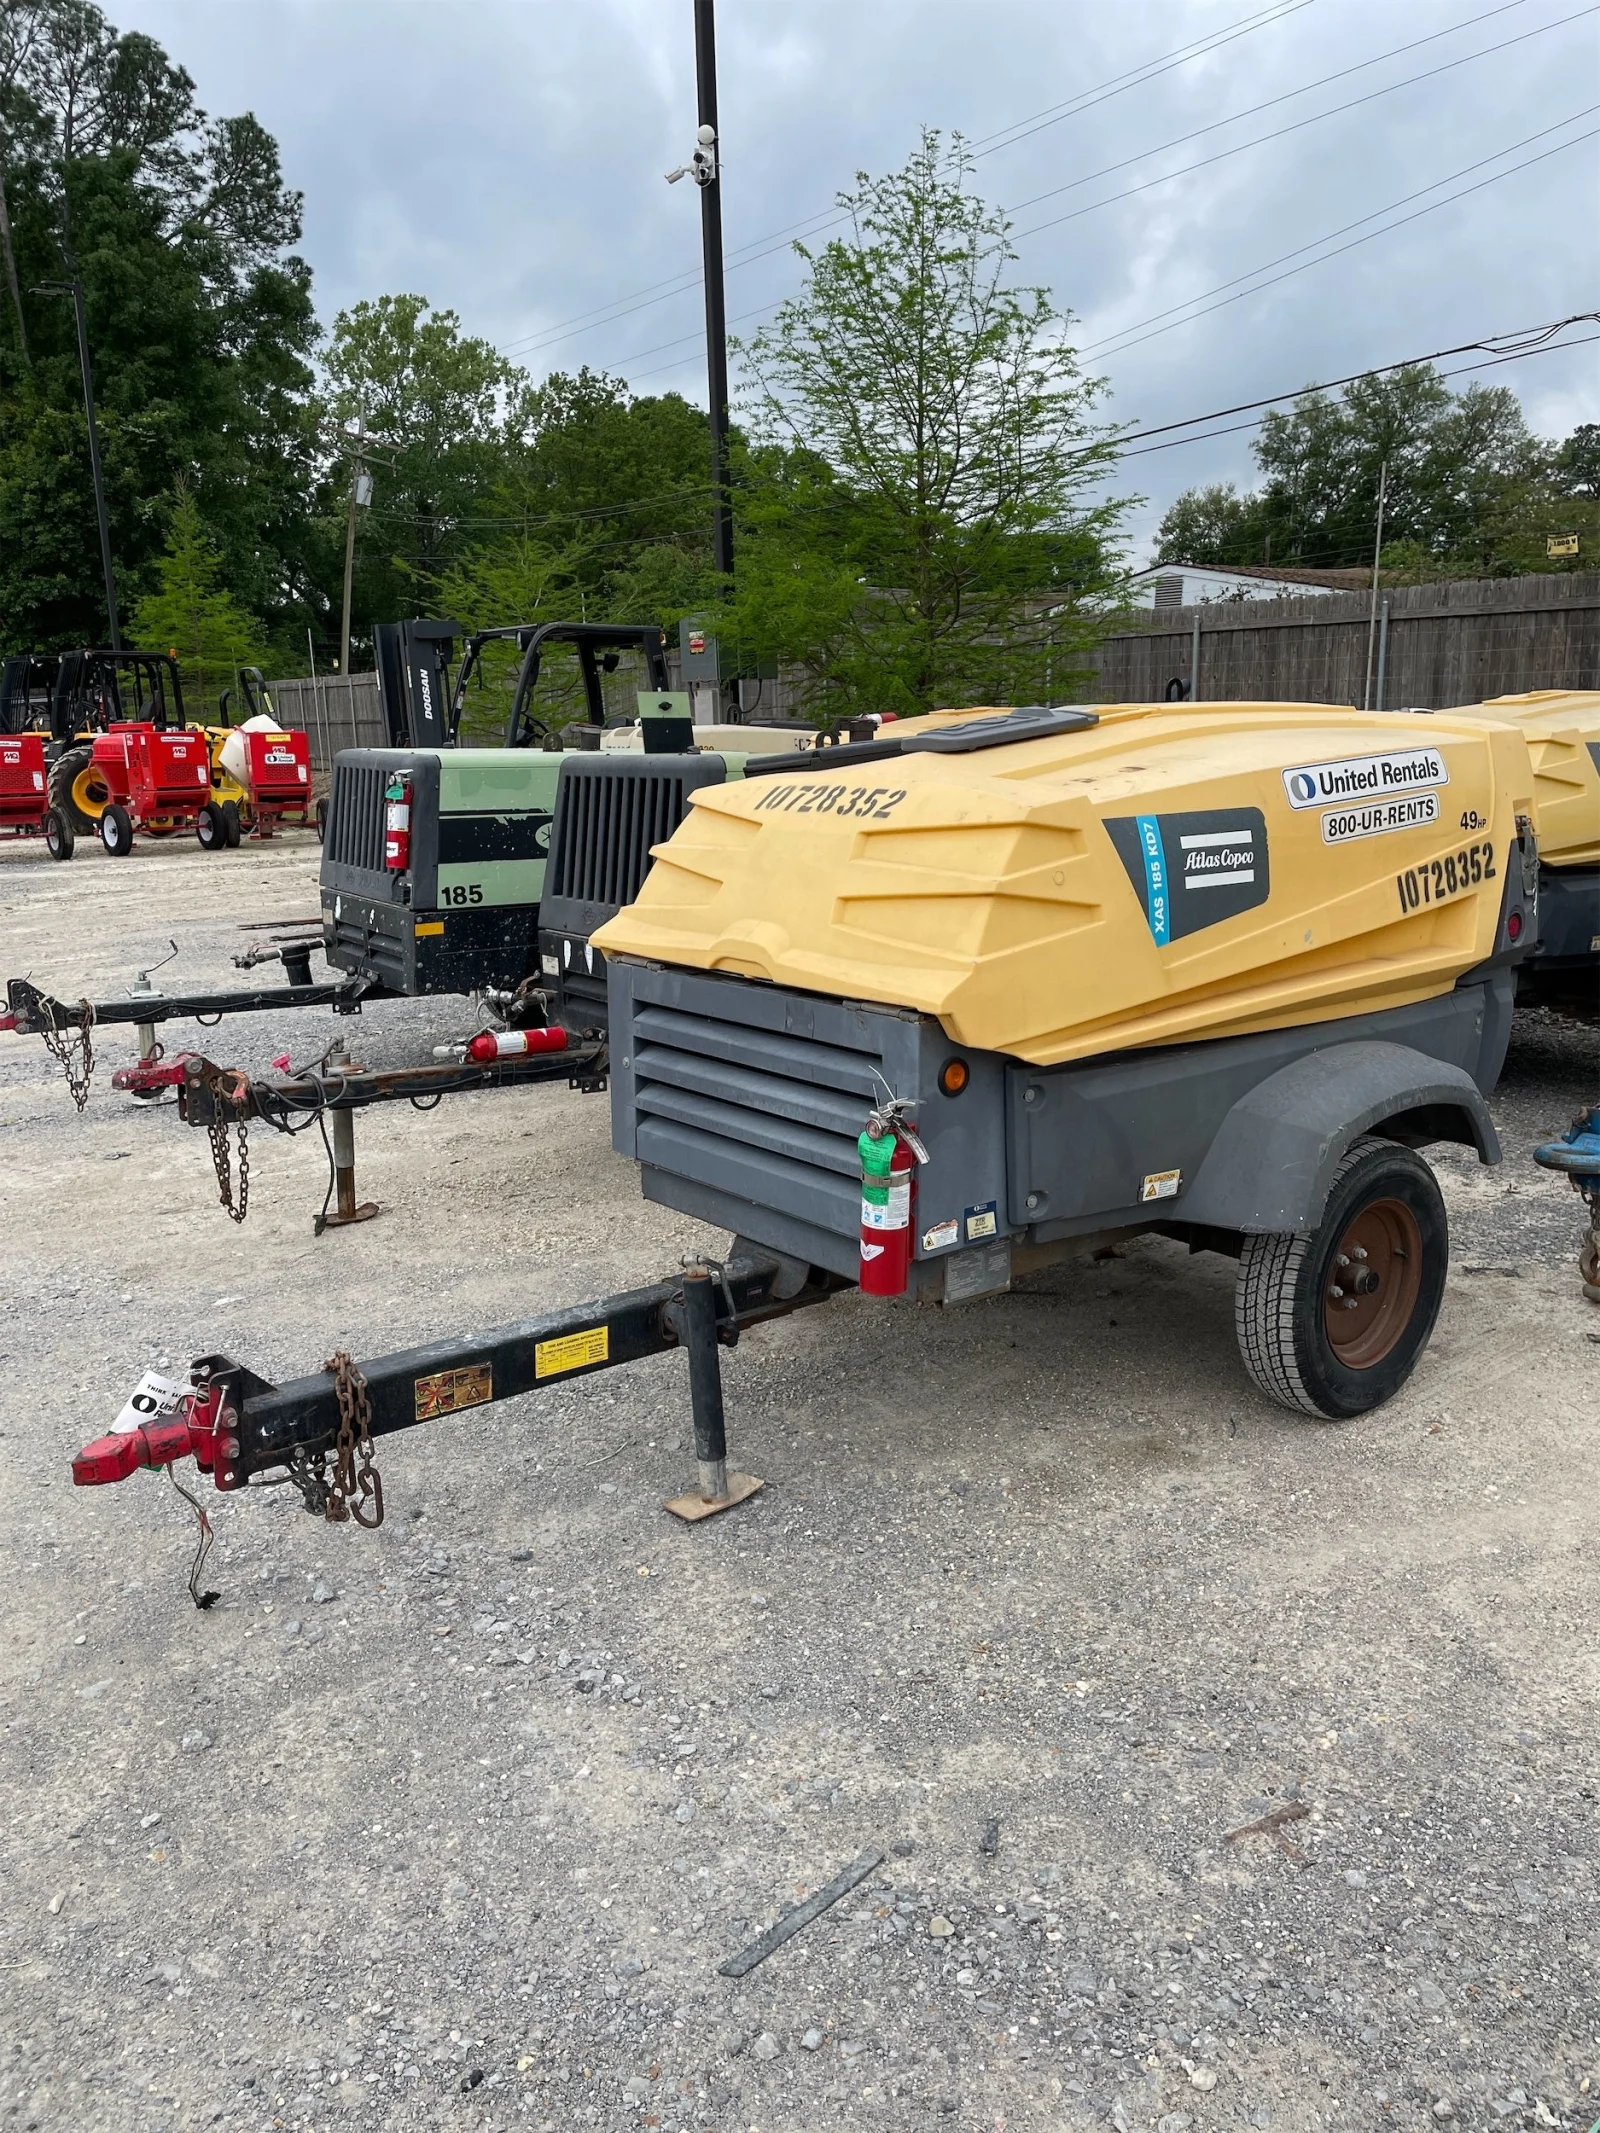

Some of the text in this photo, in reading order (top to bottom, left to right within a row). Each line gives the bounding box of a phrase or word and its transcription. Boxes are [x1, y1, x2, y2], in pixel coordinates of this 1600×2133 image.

[420, 669, 433, 720] DOOSAN
[1319, 756, 1439, 796] United Rentals
[754, 785, 907, 819] 10728352
[1328, 798, 1434, 837] 800-UR-RENTS
[441, 884, 483, 906] 185
[1143, 822, 1165, 933] XAS 185 KD7
[1397, 842, 1496, 913] 10728352
[1154, 1173, 1176, 1182] CAUTION
[147, 1384, 167, 1395] THINK
